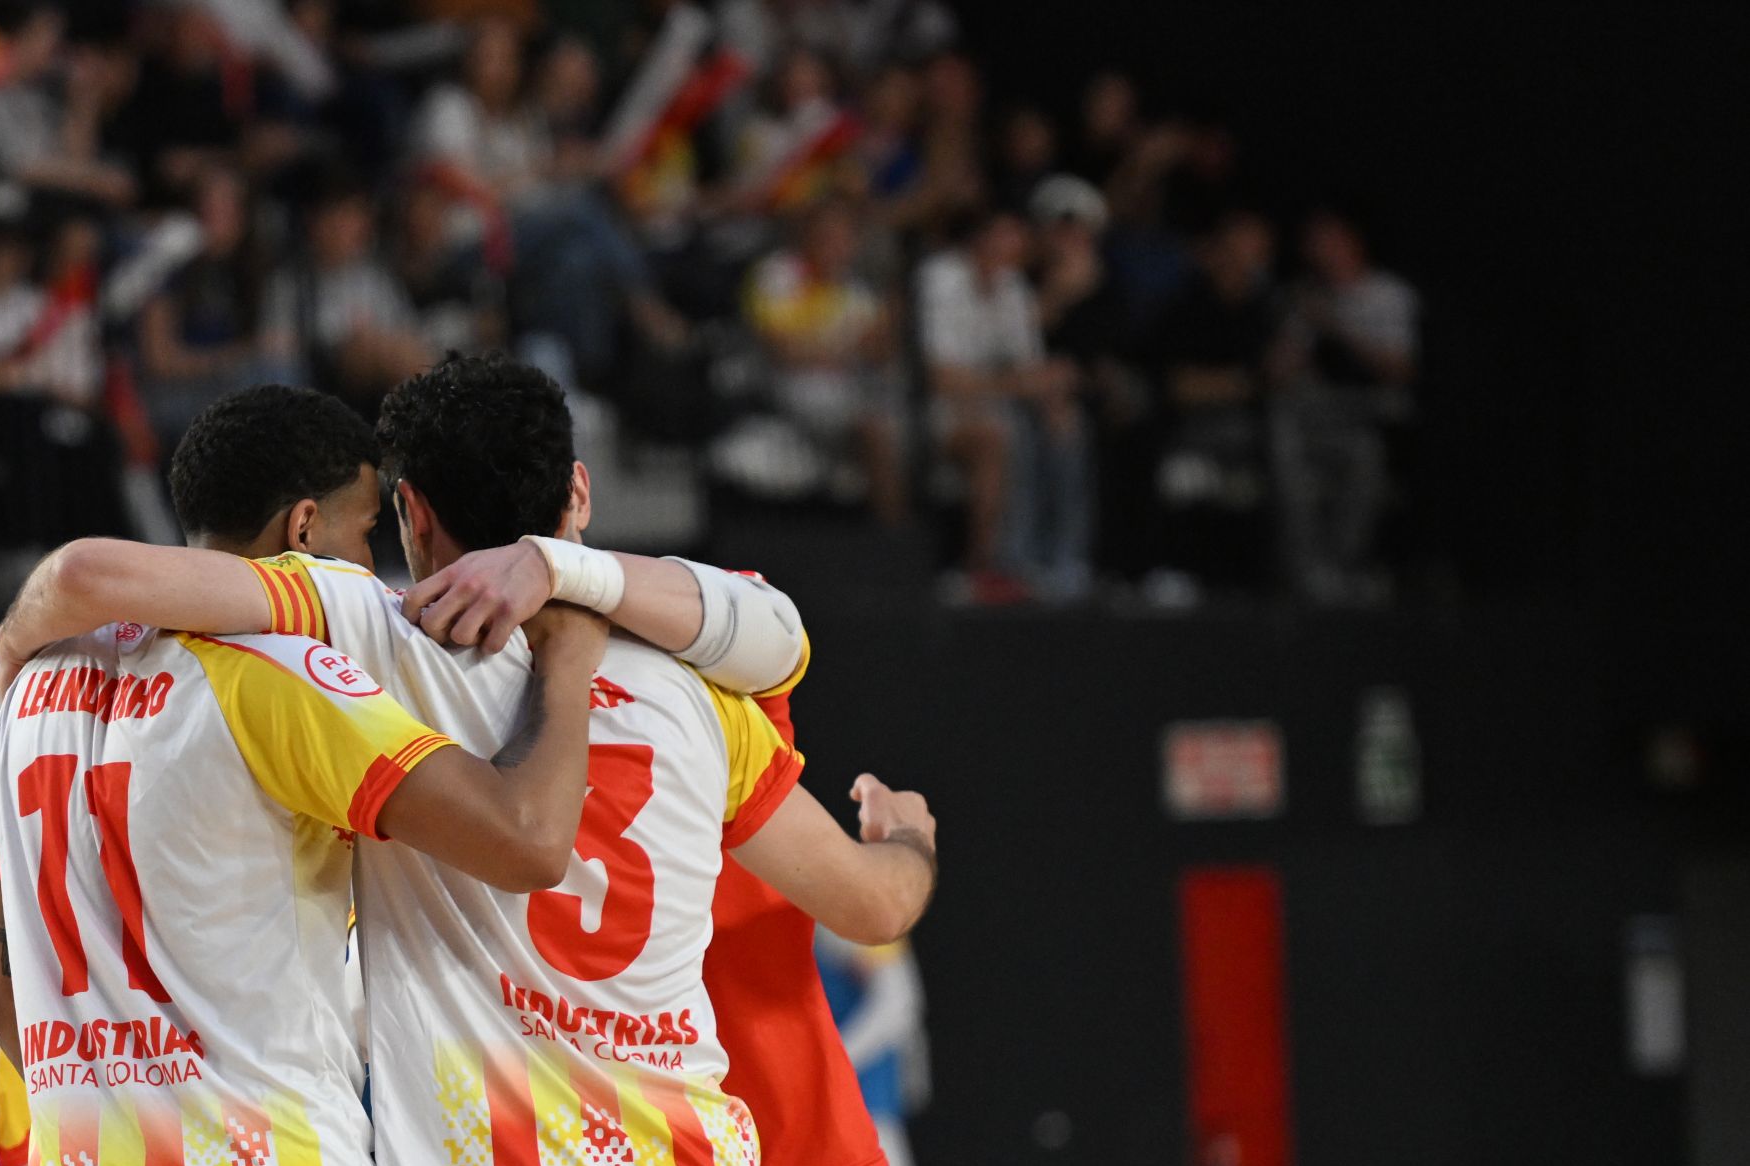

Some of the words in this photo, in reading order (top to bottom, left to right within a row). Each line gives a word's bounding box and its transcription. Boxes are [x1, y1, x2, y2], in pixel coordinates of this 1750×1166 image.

[17, 754, 174, 1004] 11
[23, 1016, 205, 1069] INDUSTRIAS
[30, 1062, 100, 1095] SANTA
[106, 1057, 203, 1087] COLOMA
